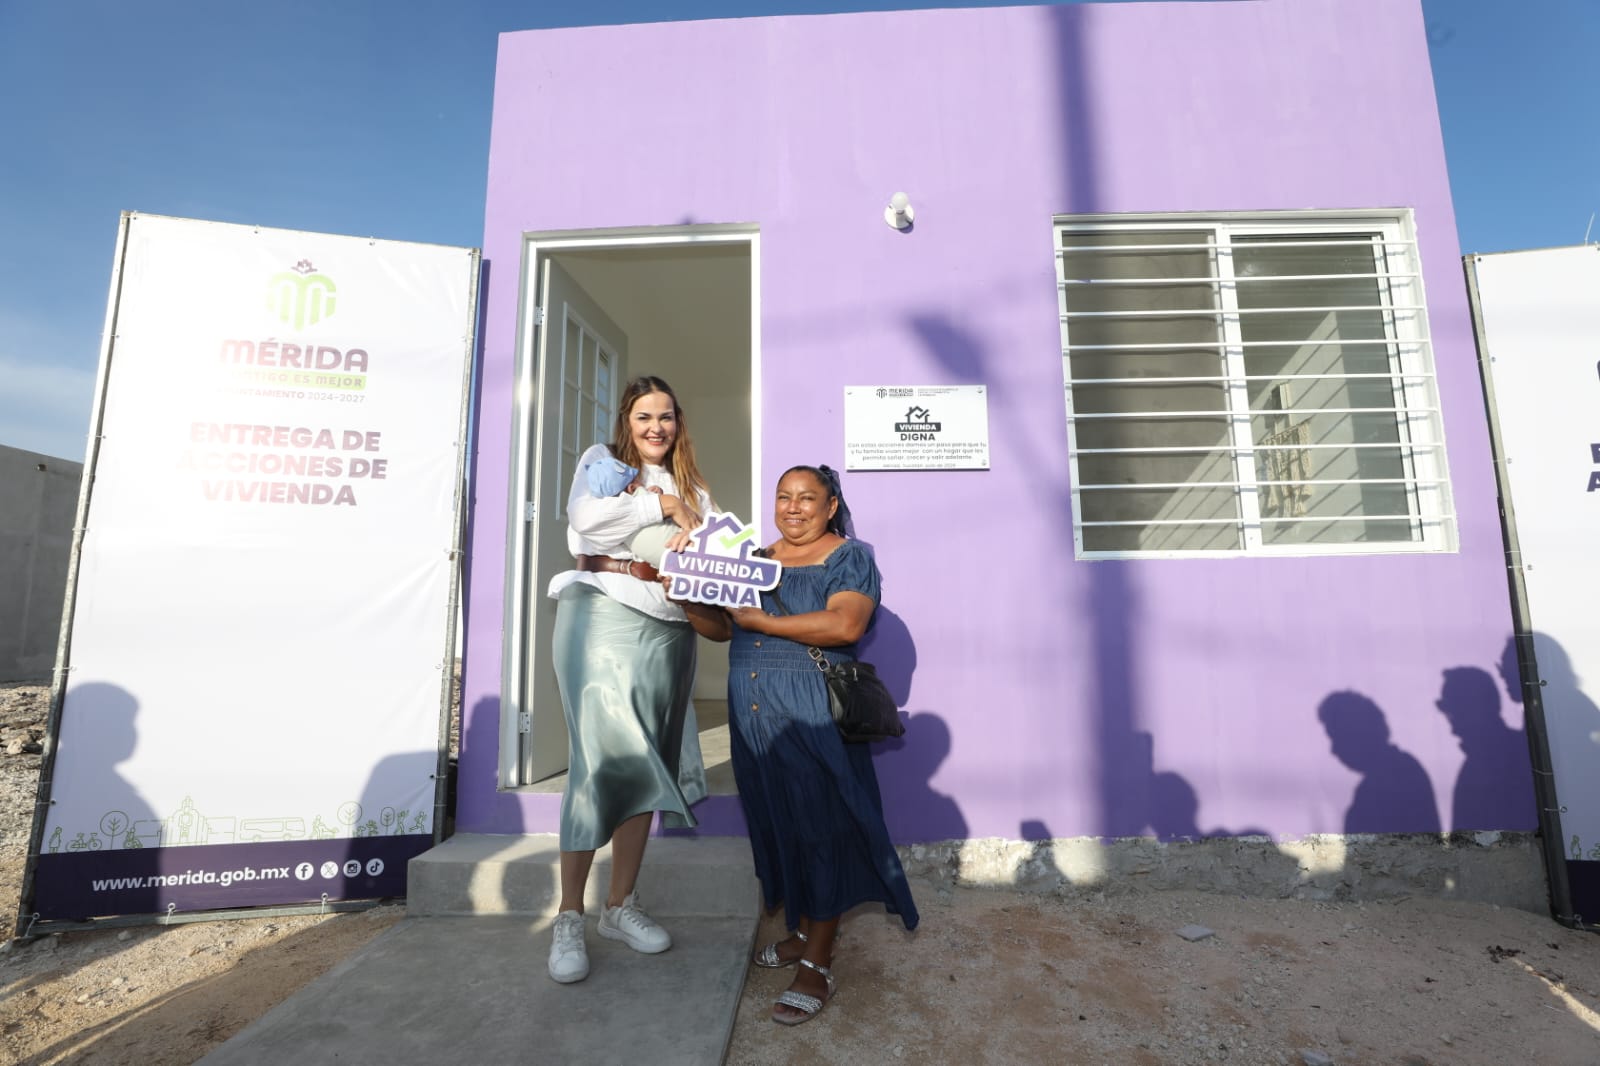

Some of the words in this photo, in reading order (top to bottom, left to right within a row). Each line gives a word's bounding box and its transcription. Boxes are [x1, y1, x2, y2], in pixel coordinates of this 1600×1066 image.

[219, 337, 369, 373] MÉRIDA
[294, 373, 310, 384] ES
[316, 374, 362, 388] MEJOR
[307, 392, 366, 404] 2024-2027
[190, 422, 336, 450] ENTREGA
[341, 430, 382, 453] DE
[900, 433, 936, 441] DIGNA
[176, 449, 343, 478] ACCIONES
[348, 457, 389, 480] DE
[201, 479, 358, 507] VIVIENDA
[678, 555, 764, 582] VIVIENDA
[673, 576, 757, 606] DIGNA
[92, 864, 290, 893] www.merida.gob.mx
